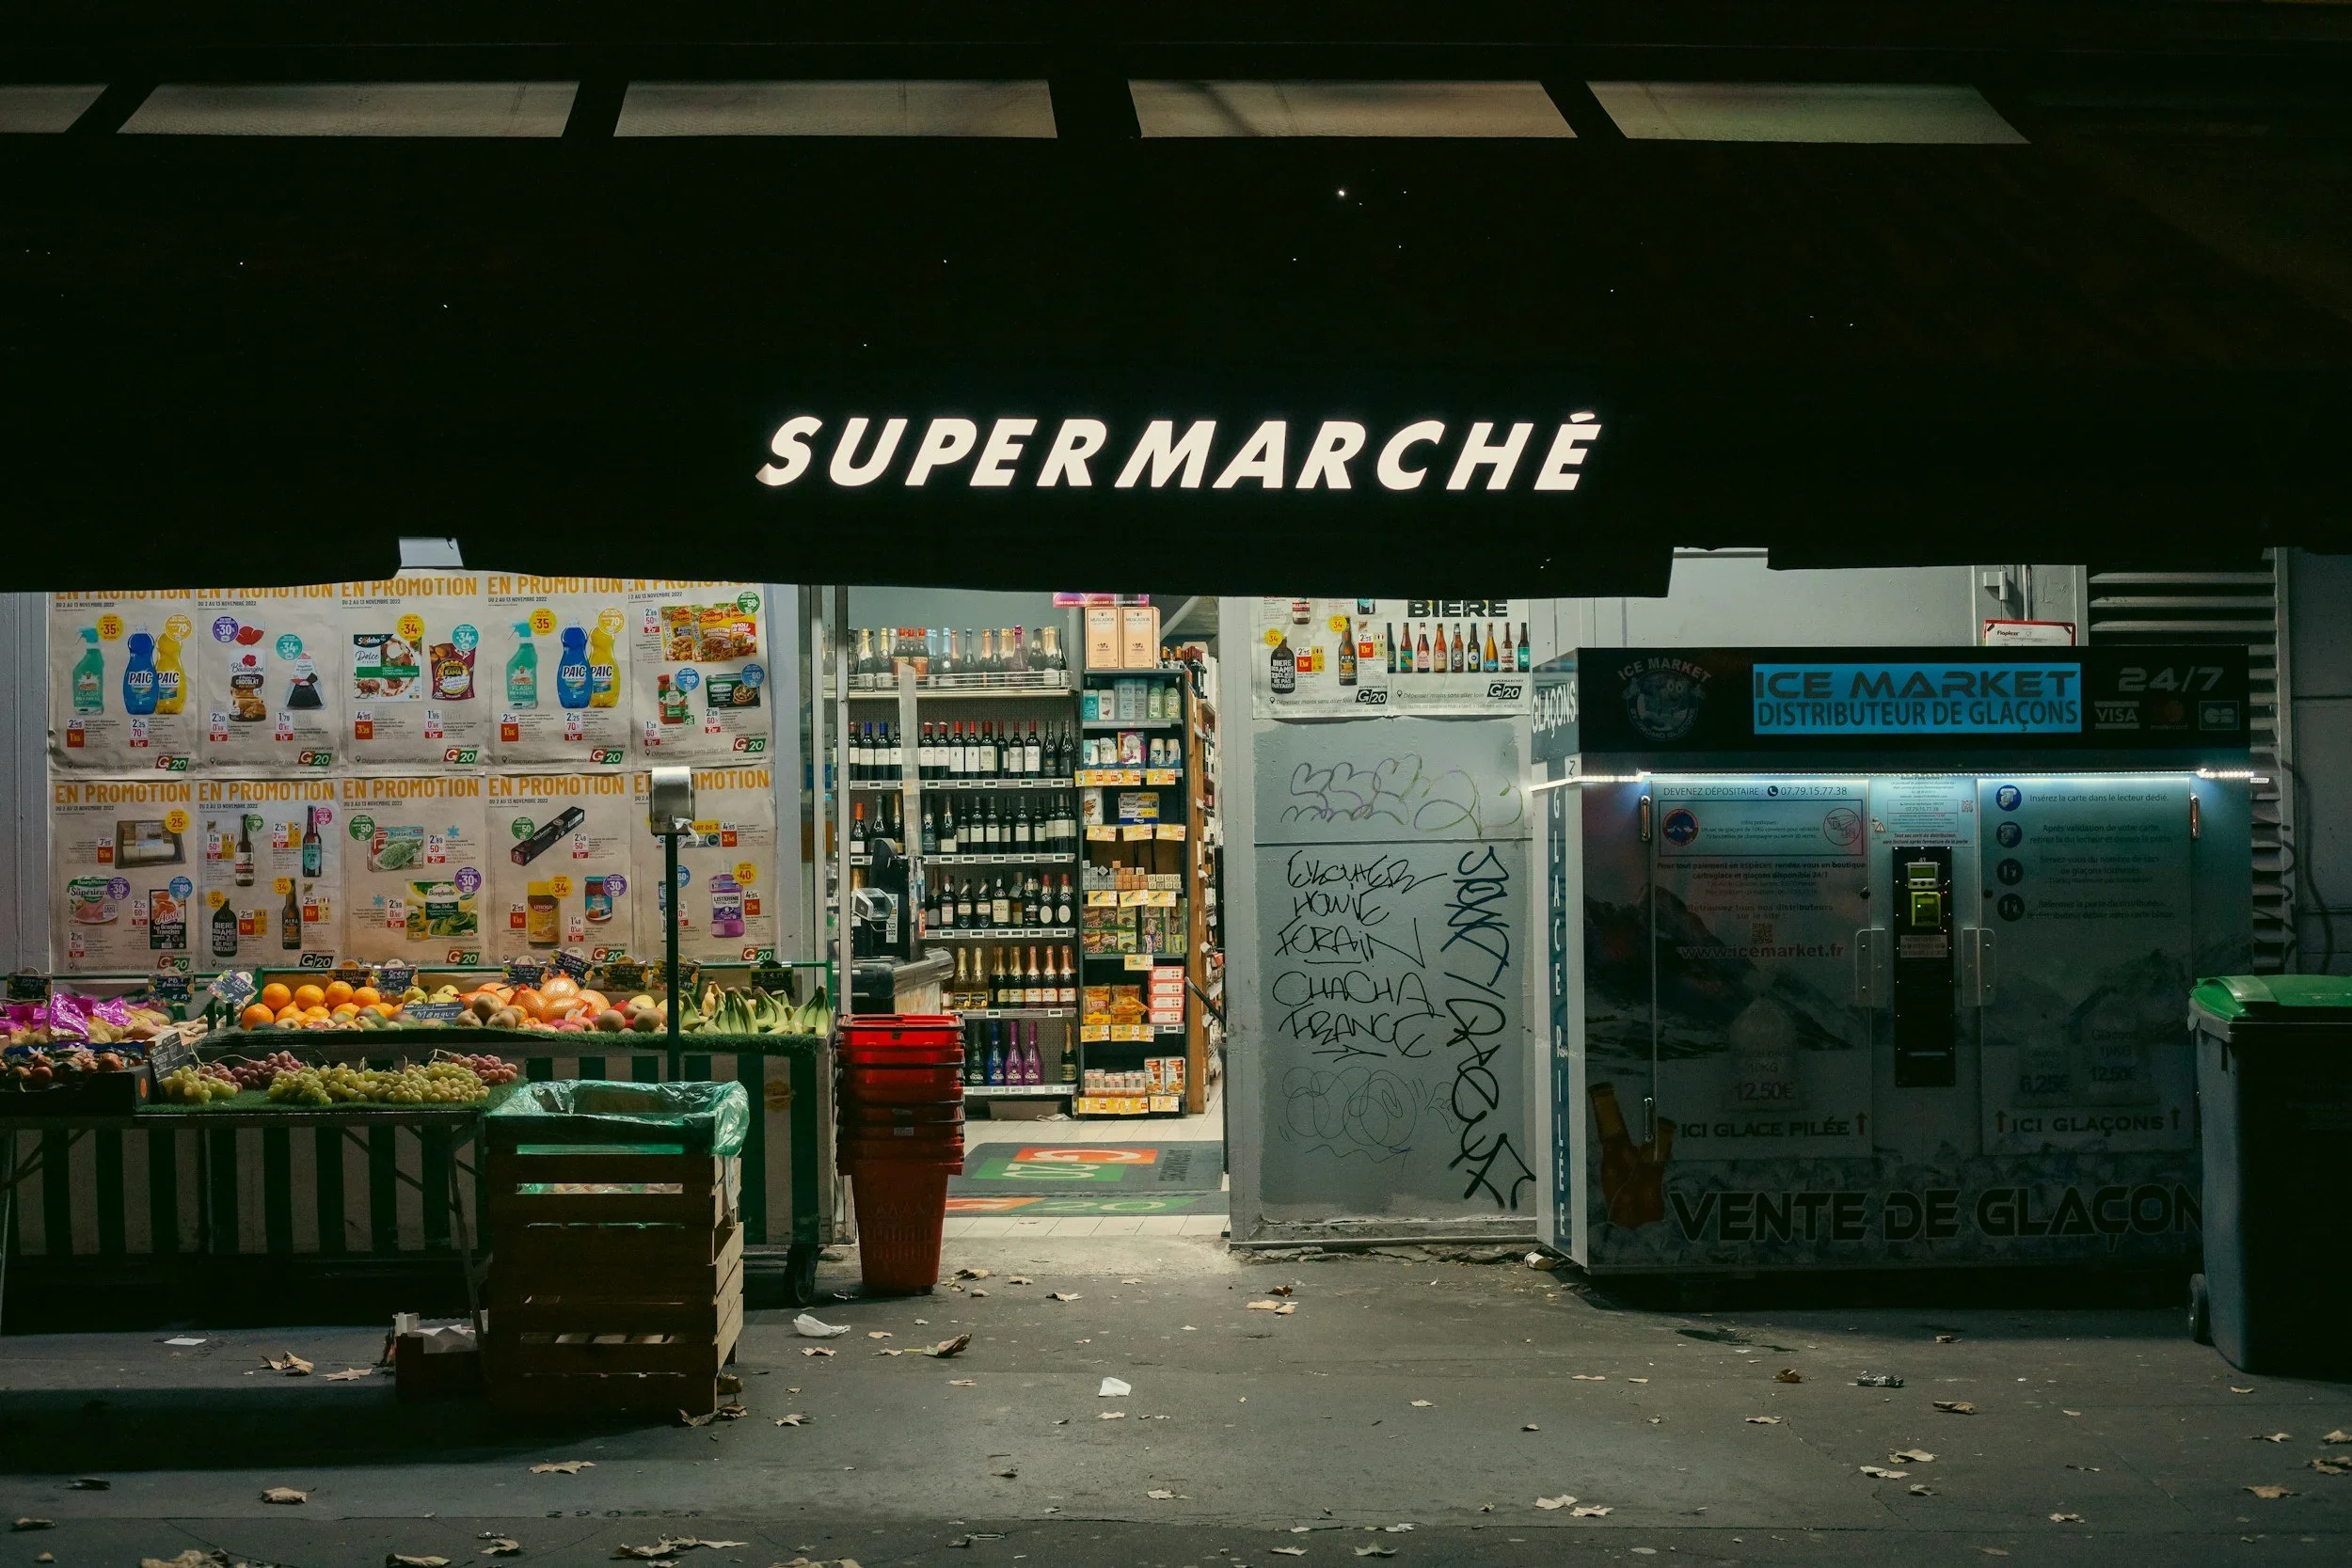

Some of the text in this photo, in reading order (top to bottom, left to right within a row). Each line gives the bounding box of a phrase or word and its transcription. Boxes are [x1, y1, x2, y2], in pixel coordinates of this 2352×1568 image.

[755, 410, 1602, 491] SUPERMARCHÉ
[342, 577, 477, 597] EN PROMOTION
[487, 576, 511, 594] EN
[517, 576, 623, 594] PROMOTION
[129, 672, 152, 684] PAIC
[563, 665, 586, 677] PAIC
[1618, 657, 1712, 683] ICE MARKET
[2118, 665, 2224, 692] 24/7
[1489, 685, 1519, 698] G20
[1755, 671, 2078, 699] ICE MARKET
[1358, 690, 1386, 704] G20
[1532, 680, 1576, 739] GLAÇONS
[1757, 699, 2078, 732] DISTRIBUTEUR DE GLAÇONS
[2094, 707, 2138, 722] VISA
[735, 738, 764, 752] G20
[300, 751, 329, 765] G20
[445, 749, 475, 763] G20
[592, 750, 621, 763] G20
[55, 784, 191, 804] EN PROMOTION
[199, 782, 335, 801] EN PROMOTION
[342, 779, 479, 799] EN PROMOTION
[489, 776, 625, 797] EN PROMOTION
[1663, 786, 1848, 796] DEVENEZ DÉPOSITAIRE 07.79.15.77.38
[448, 952, 478, 964] G20
[743, 948, 772, 961] G20
[1677, 943, 1846, 959] www.icemarket.fr
[301, 955, 331, 968] G20
[1681, 1115, 1850, 1138] ICI GLACE PILÉE
[2011, 1116, 2164, 1137] ICI GLAÇONS
[1668, 1191, 1869, 1243] VENTE
[1883, 1188, 1962, 1243] DE
